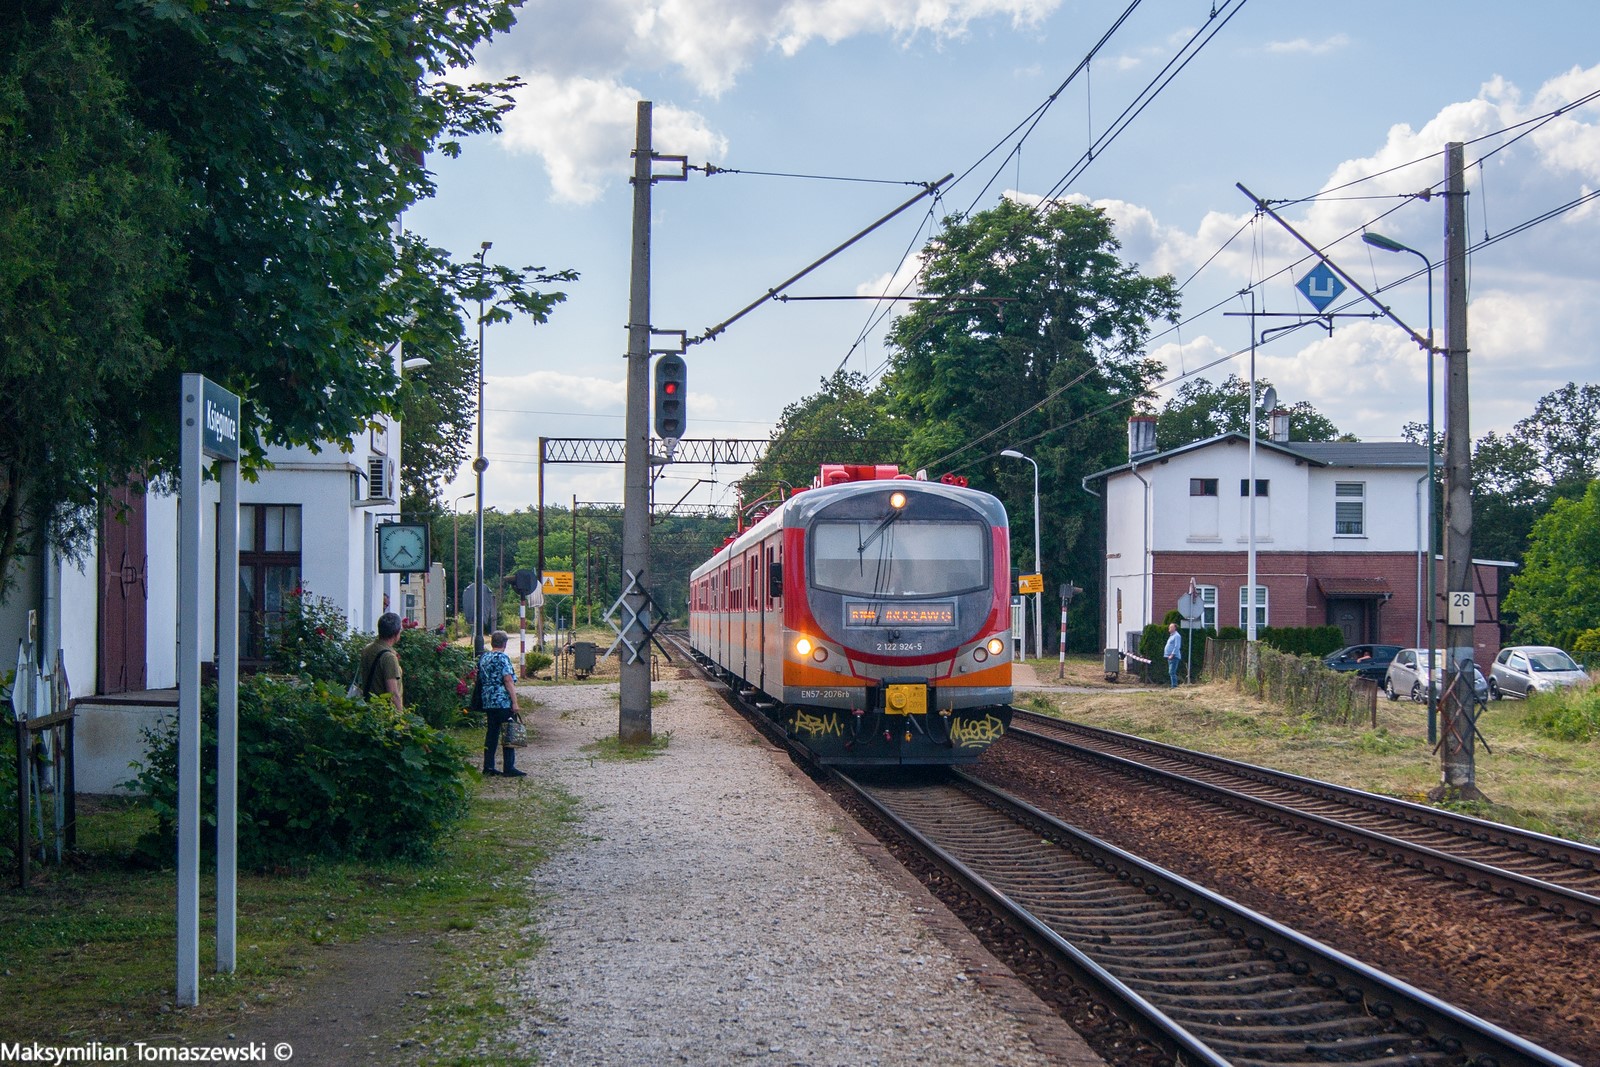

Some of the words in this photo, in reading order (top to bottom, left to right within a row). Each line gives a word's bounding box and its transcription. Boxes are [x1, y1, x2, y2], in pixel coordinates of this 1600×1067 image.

[206, 399, 236, 443] Księginice
[1454, 594, 1470, 607] 26
[1459, 610, 1465, 623] 1
[884, 643, 897, 651] 122
[899, 643, 923, 651] 924-5
[801, 690, 850, 699] EN57-2076rb
